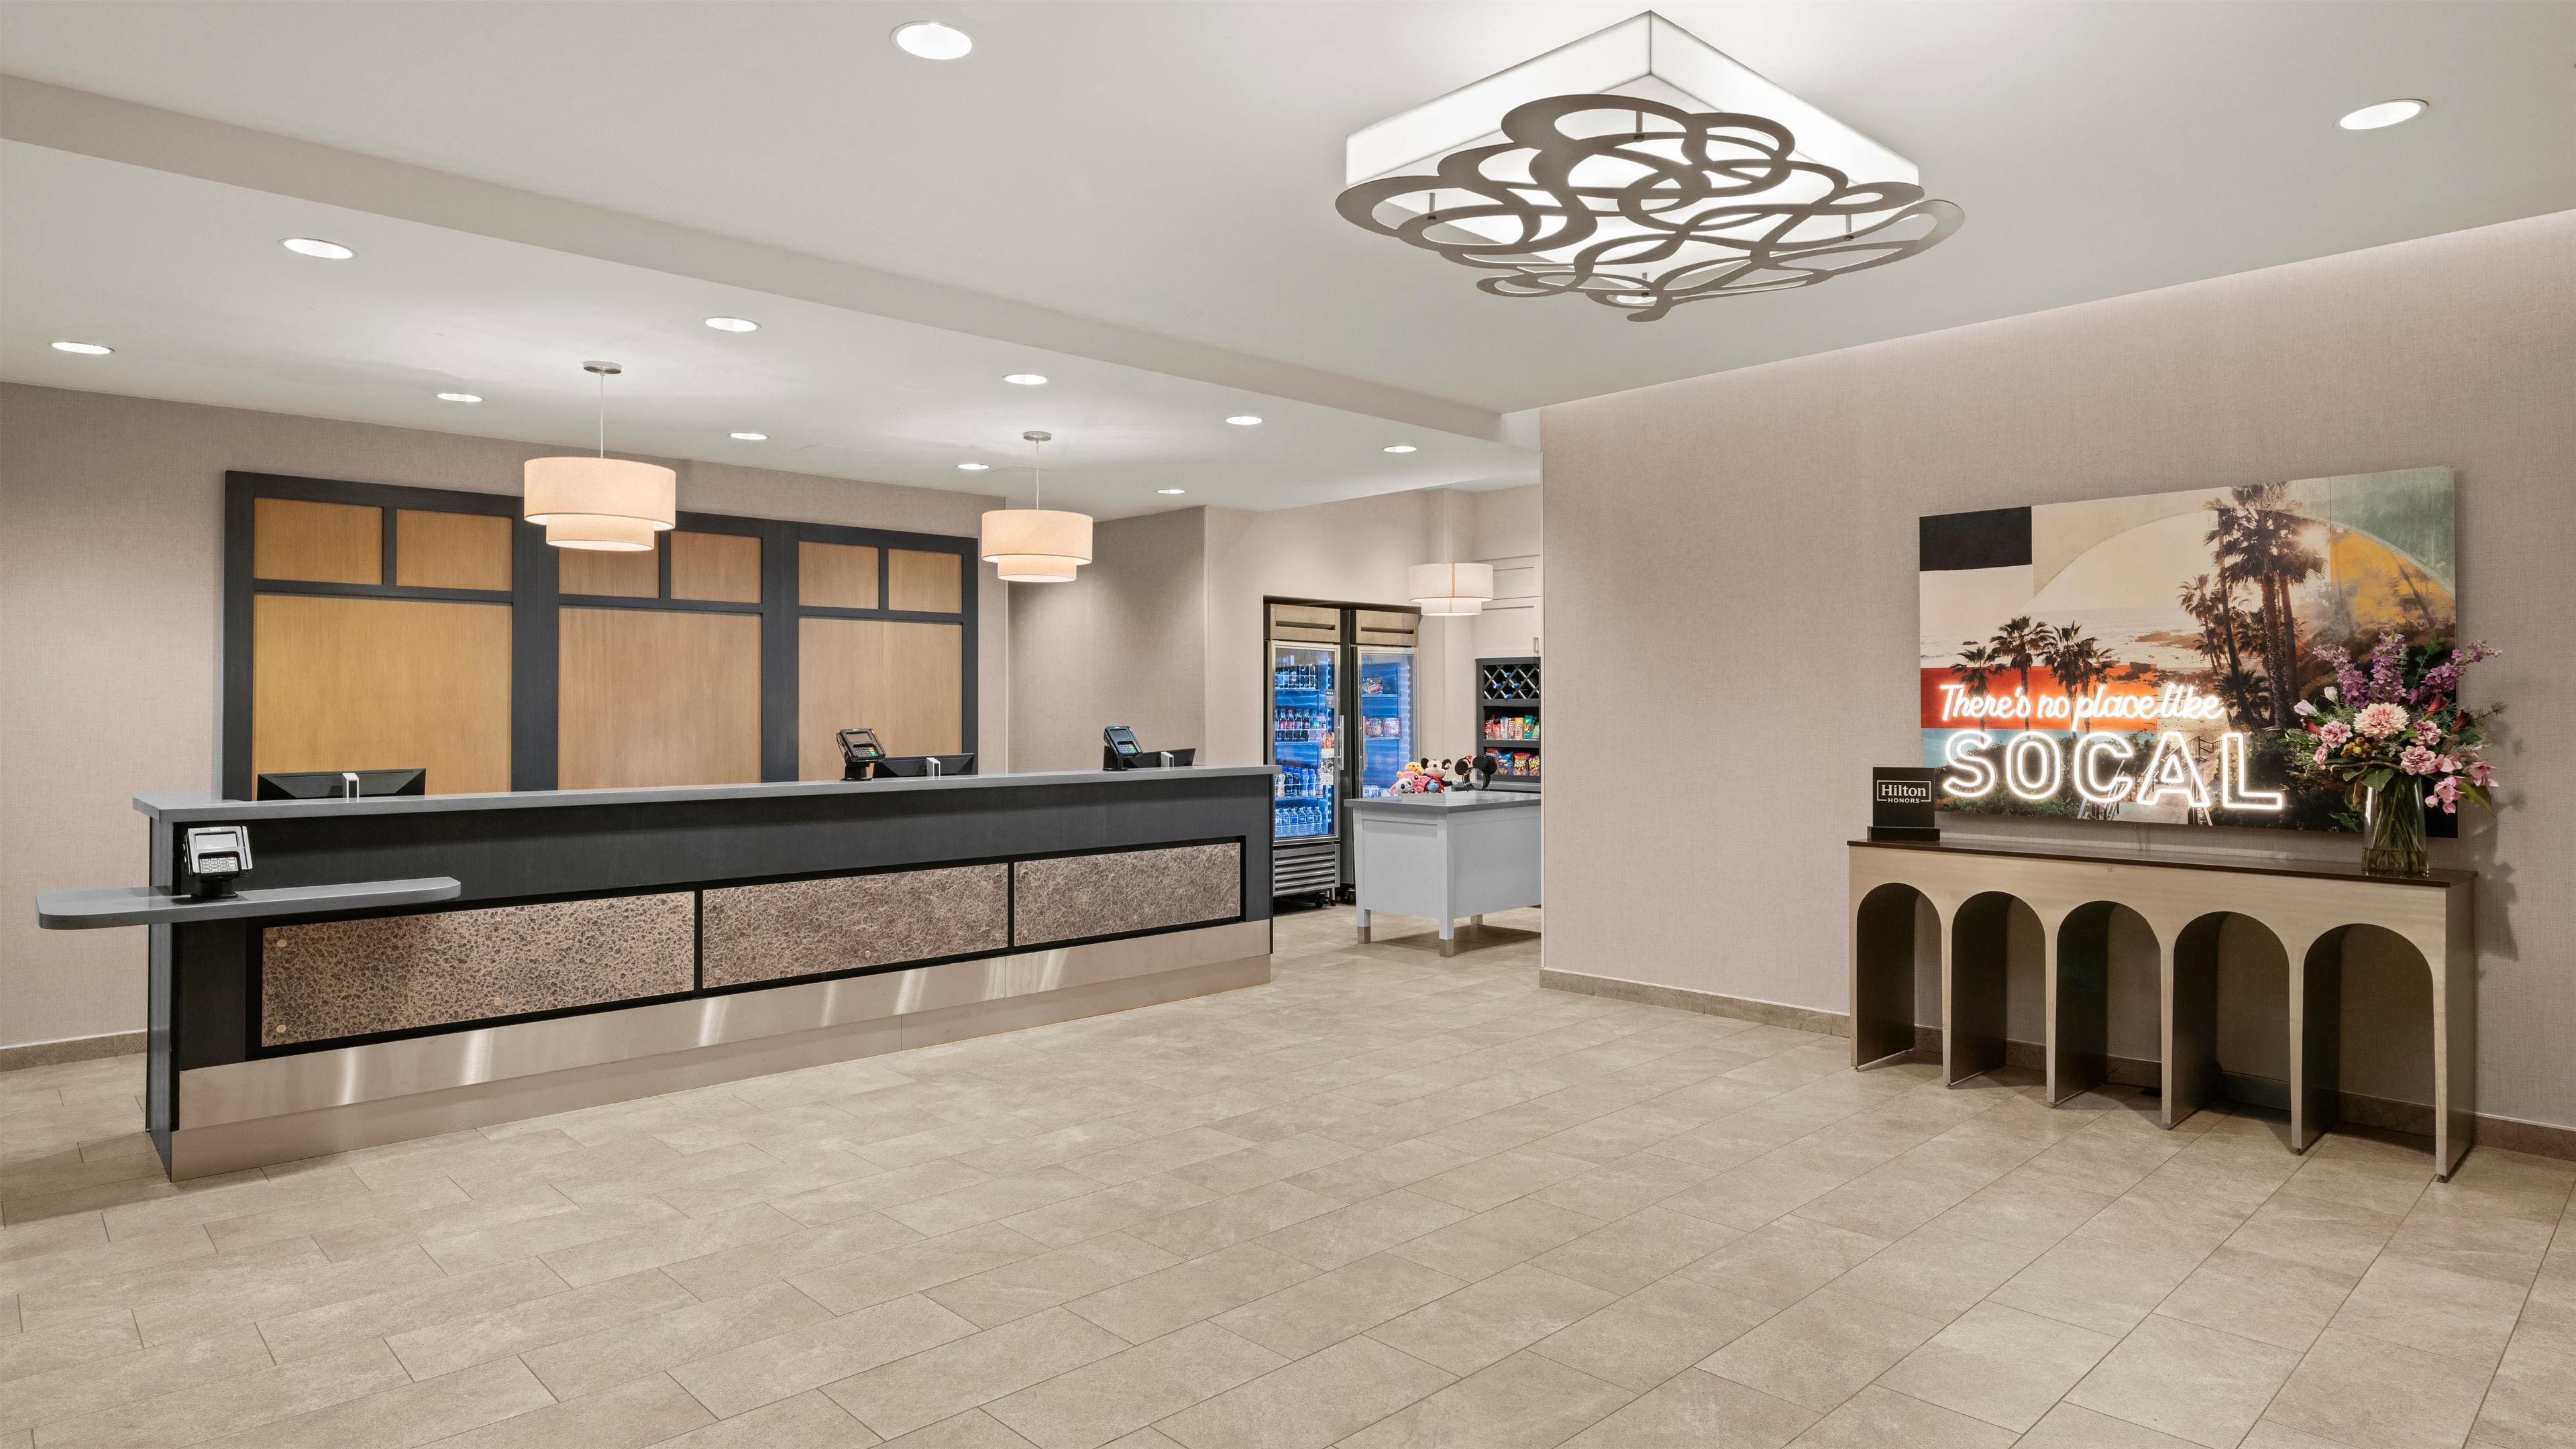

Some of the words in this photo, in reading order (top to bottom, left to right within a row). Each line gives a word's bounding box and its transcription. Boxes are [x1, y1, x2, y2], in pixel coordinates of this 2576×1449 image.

[1939, 683, 2031, 721] There's
[2037, 694, 2070, 718] no
[2071, 684, 2158, 731] place
[2158, 682, 2226, 720] like
[1881, 784, 1927, 796] Hilton
[1943, 730, 2283, 810] SOCAL
